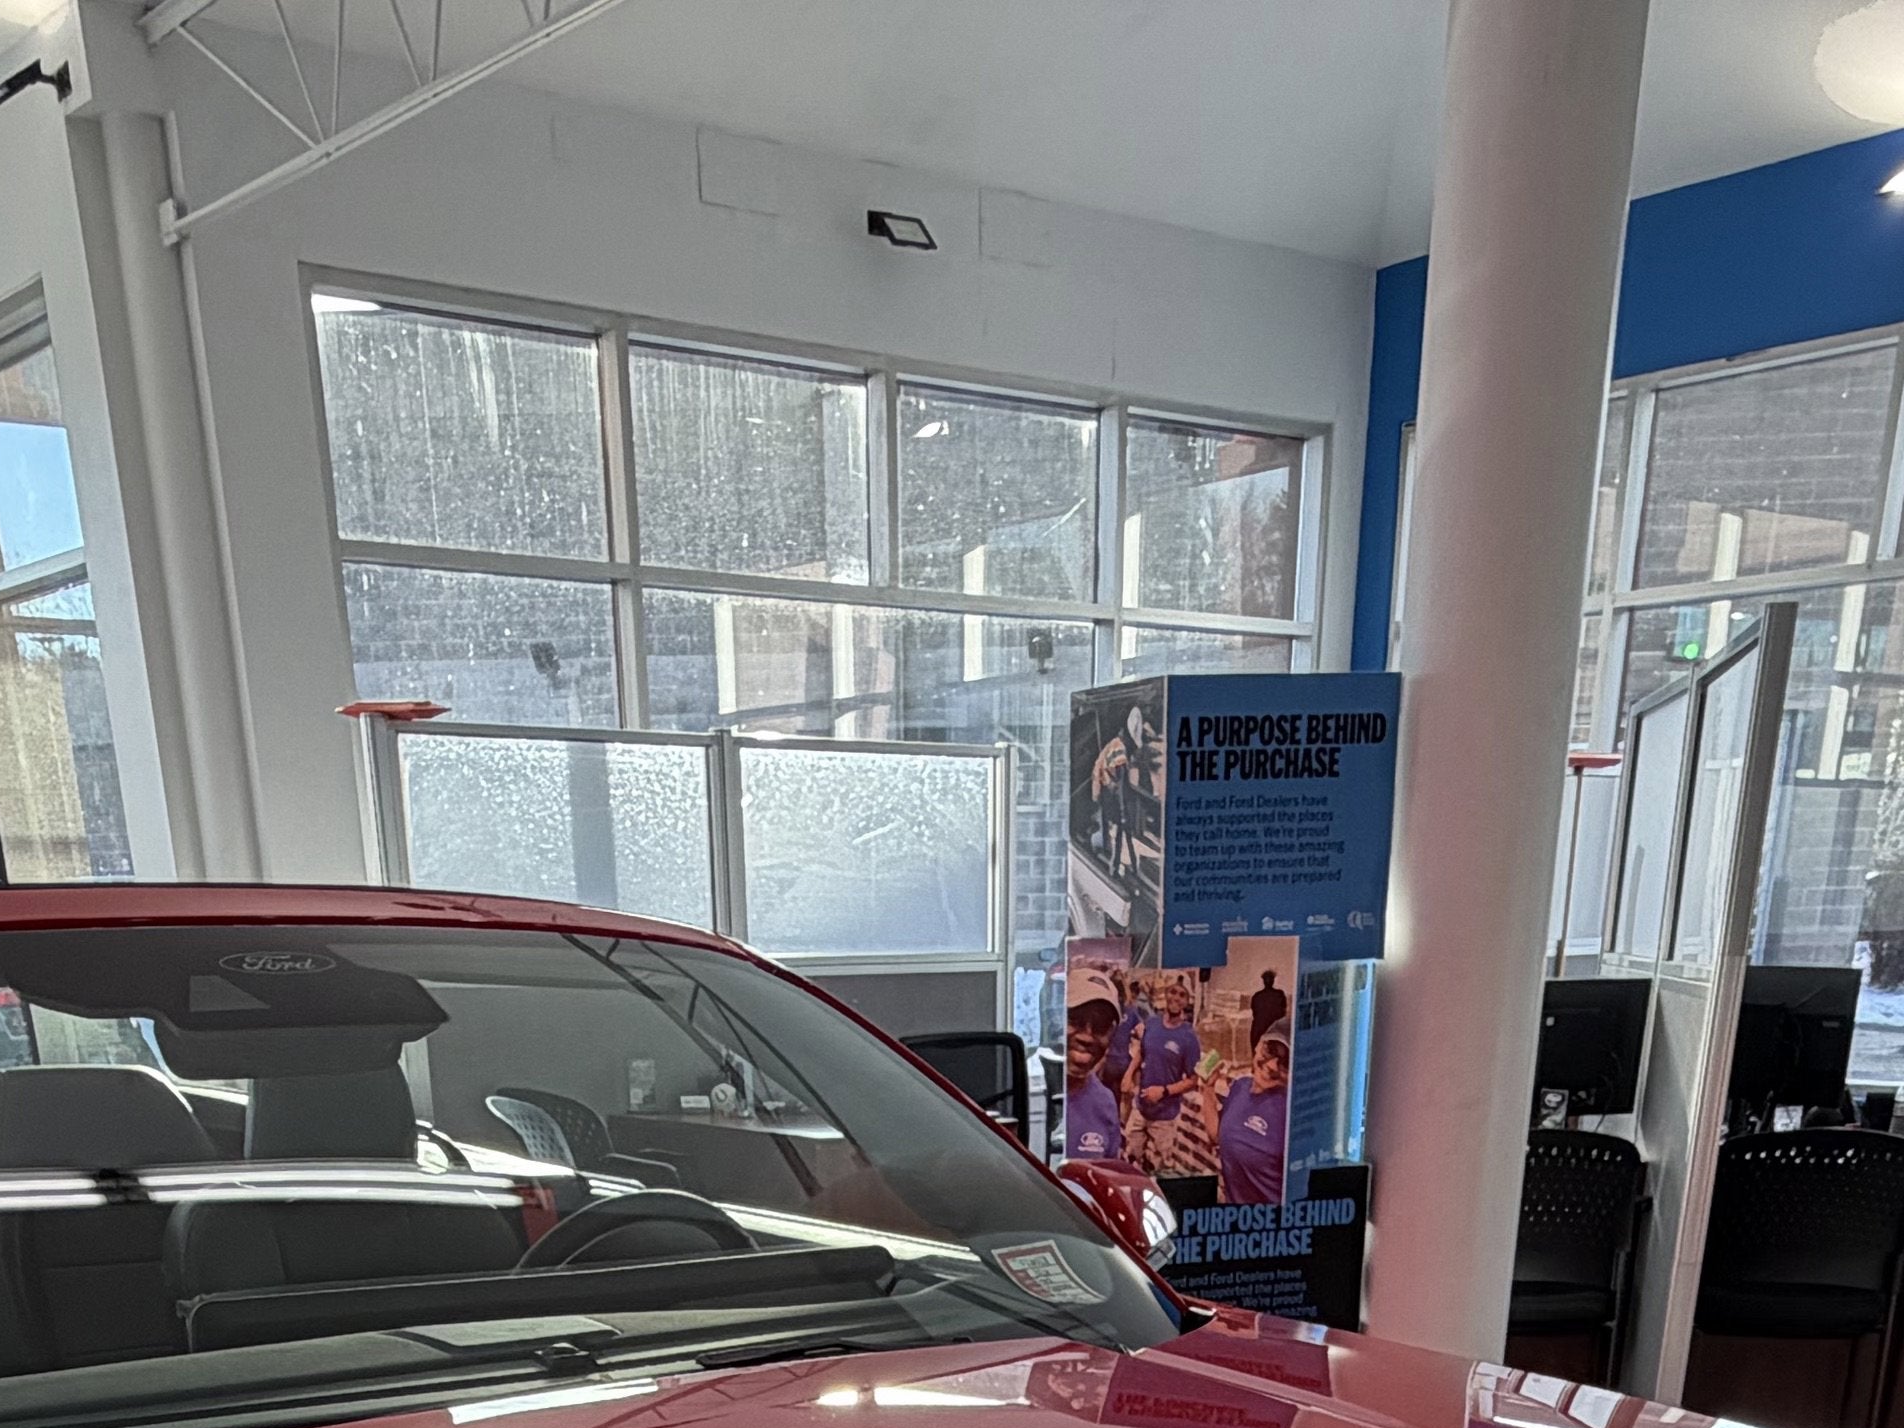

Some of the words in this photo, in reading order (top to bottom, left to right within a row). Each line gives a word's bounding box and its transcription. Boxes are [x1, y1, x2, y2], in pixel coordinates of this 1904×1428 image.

[1176, 716, 1193, 748] A
[1197, 714, 1302, 748] PURPOSE
[1306, 712, 1387, 745] BEHIND
[1176, 750, 1219, 782] THE
[1223, 747, 1341, 781] PURCHASE
[1176, 796, 1202, 811] Ford
[1205, 796, 1226, 810] and
[1228, 795, 1254, 809] Ford
[1256, 794, 1300, 808] Dealers
[1301, 793, 1328, 807] have
[1175, 813, 1214, 827] always
[1216, 810, 1275, 827] supported
[1277, 810, 1295, 822] the
[1298, 809, 1334, 824] places
[1175, 828, 1200, 842] they
[1203, 827, 1223, 841] call
[1263, 825, 1294, 838] We're
[1296, 825, 1330, 840] proud
[1174, 844, 1188, 857] to
[1189, 844, 1218, 857] team
[1220, 844, 1237, 860] up
[1264, 840, 1296, 853] these
[1298, 839, 1345, 854] amazing
[1173, 858, 1251, 874] organizations
[1253, 857, 1266, 869] to
[1267, 857, 1306, 869] ensure
[1307, 854, 1330, 867] that
[1173, 876, 1193, 888] our
[1196, 873, 1269, 887] communities
[1291, 868, 1342, 885] prepared
[1173, 889, 1195, 902] and
[242, 955, 315, 971] Ford
[1182, 1203, 1277, 1236] PURPOSE
[1280, 1197, 1356, 1229] BEHIND
[1205, 1228, 1313, 1262] PURCHASE
[1210, 1272, 1234, 1286] Ford
[1235, 1269, 1275, 1284] Dealers
